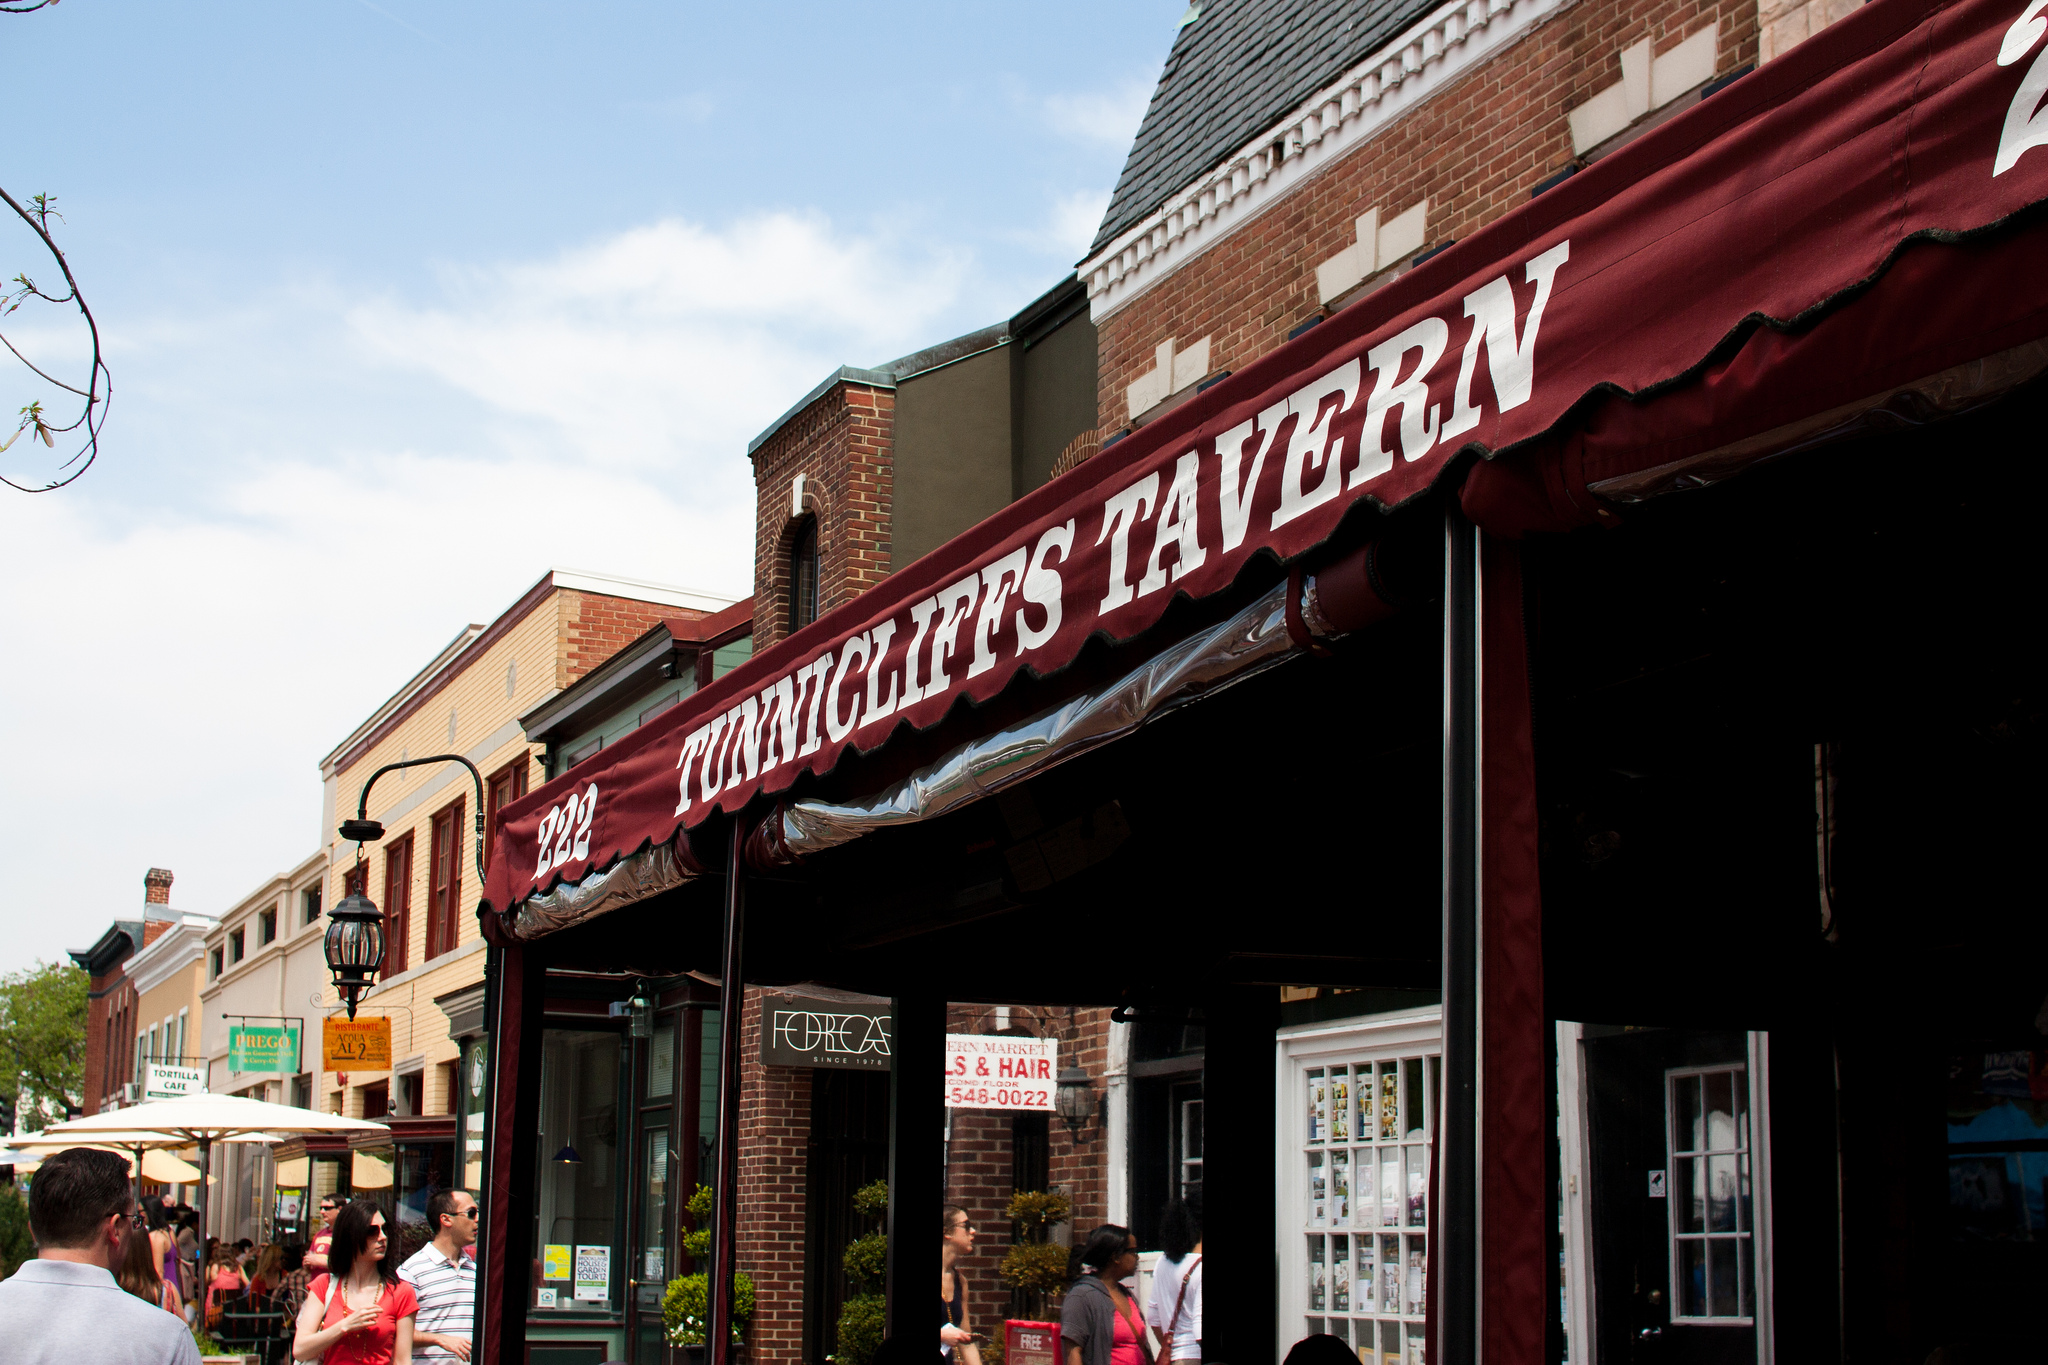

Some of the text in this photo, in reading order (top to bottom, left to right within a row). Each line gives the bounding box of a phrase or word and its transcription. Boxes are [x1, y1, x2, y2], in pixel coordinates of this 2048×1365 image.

[530, 238, 1570, 881] 222 TUNNICLIFFS TAVERN
[335, 1023, 380, 1031] RISTORANTE
[236, 1035, 291, 1048] PREGO
[331, 1033, 366, 1045] ACQUA
[331, 1043, 356, 1056] AL
[358, 1043, 366, 1060] 2
[984, 1042, 1048, 1055] MARKET
[813, 1056, 848, 1064] SINCE
[976, 1056, 990, 1077] &
[999, 1057, 1051, 1079] HAIR
[154, 1069, 200, 1080] TORTILLA
[163, 1081, 187, 1090] CAFE
[1020, 1333, 1042, 1350] FREE
